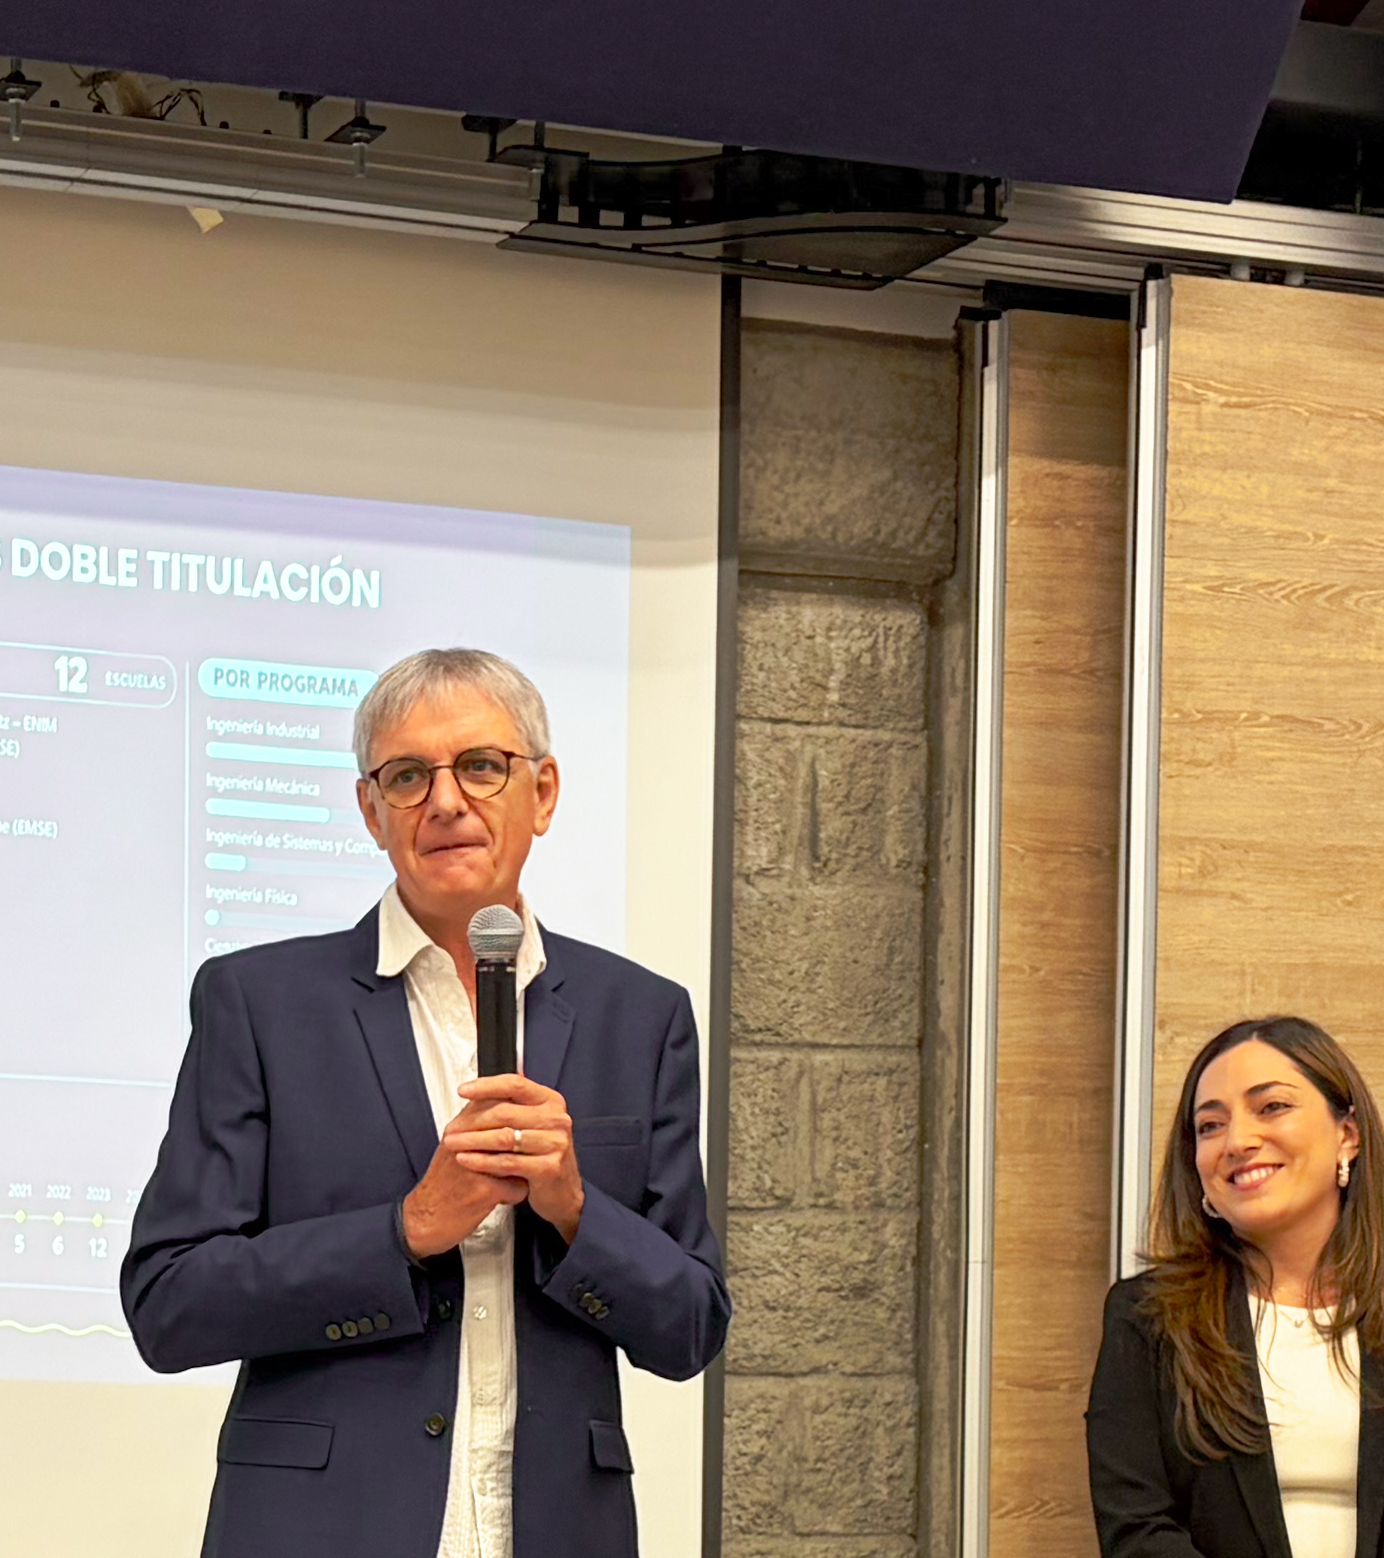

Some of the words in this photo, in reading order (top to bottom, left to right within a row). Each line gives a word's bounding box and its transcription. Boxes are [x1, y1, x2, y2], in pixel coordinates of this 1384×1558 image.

[12, 538, 138, 587] DOBLE
[147, 551, 381, 608] TITULACIÓN
[55, 655, 88, 693] 12
[105, 670, 166, 690] ESCUELAS
[214, 667, 250, 689] POR
[257, 672, 359, 697] PROGRAMA
[206, 715, 263, 736] Ingeniería
[266, 721, 320, 740] Industrial
[206, 772, 263, 793] Ingeniería
[265, 777, 320, 796] Mecánica
[13, 818, 58, 839] (EMSE)
[206, 827, 263, 848] Ingeniería
[265, 833, 280, 848] de
[282, 832, 334, 852] Sistemas
[335, 841, 344, 856] y
[205, 883, 263, 904] Ingeniería
[8, 1183, 32, 1198] 2021
[46, 1184, 71, 1200] 2022
[14, 1234, 25, 1254] 5
[52, 1235, 64, 1256] 6
[89, 1238, 107, 1258] 12
